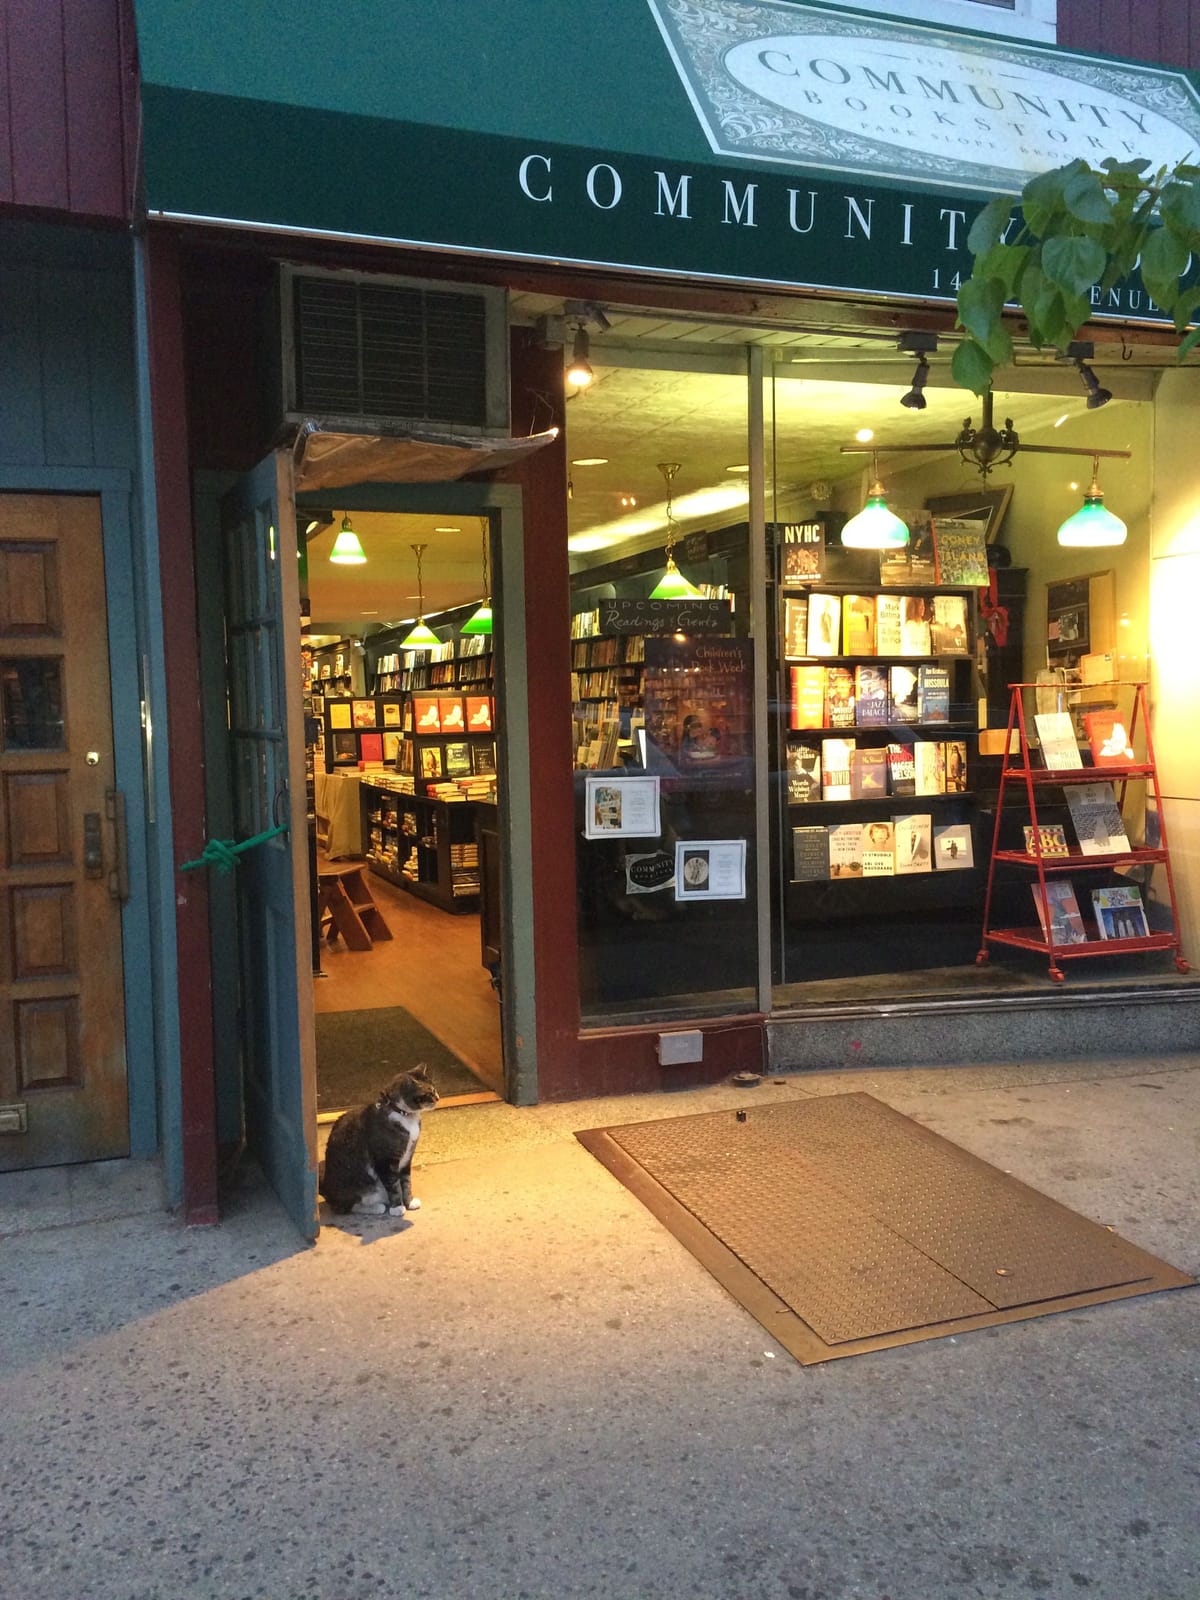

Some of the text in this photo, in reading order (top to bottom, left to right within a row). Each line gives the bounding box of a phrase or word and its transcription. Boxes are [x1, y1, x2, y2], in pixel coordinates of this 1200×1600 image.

[758, 50, 1152, 135] COMMUNITY
[803, 89, 1143, 154] BOOKSTORE
[932, 268, 974, 291] 14
[784, 524, 820, 544] NYHC
[941, 535, 980, 545] CONEY
[608, 602, 719, 611] UPCOMING
[605, 610, 665, 631] Readings
[1029, 832, 1066, 849] ABC
